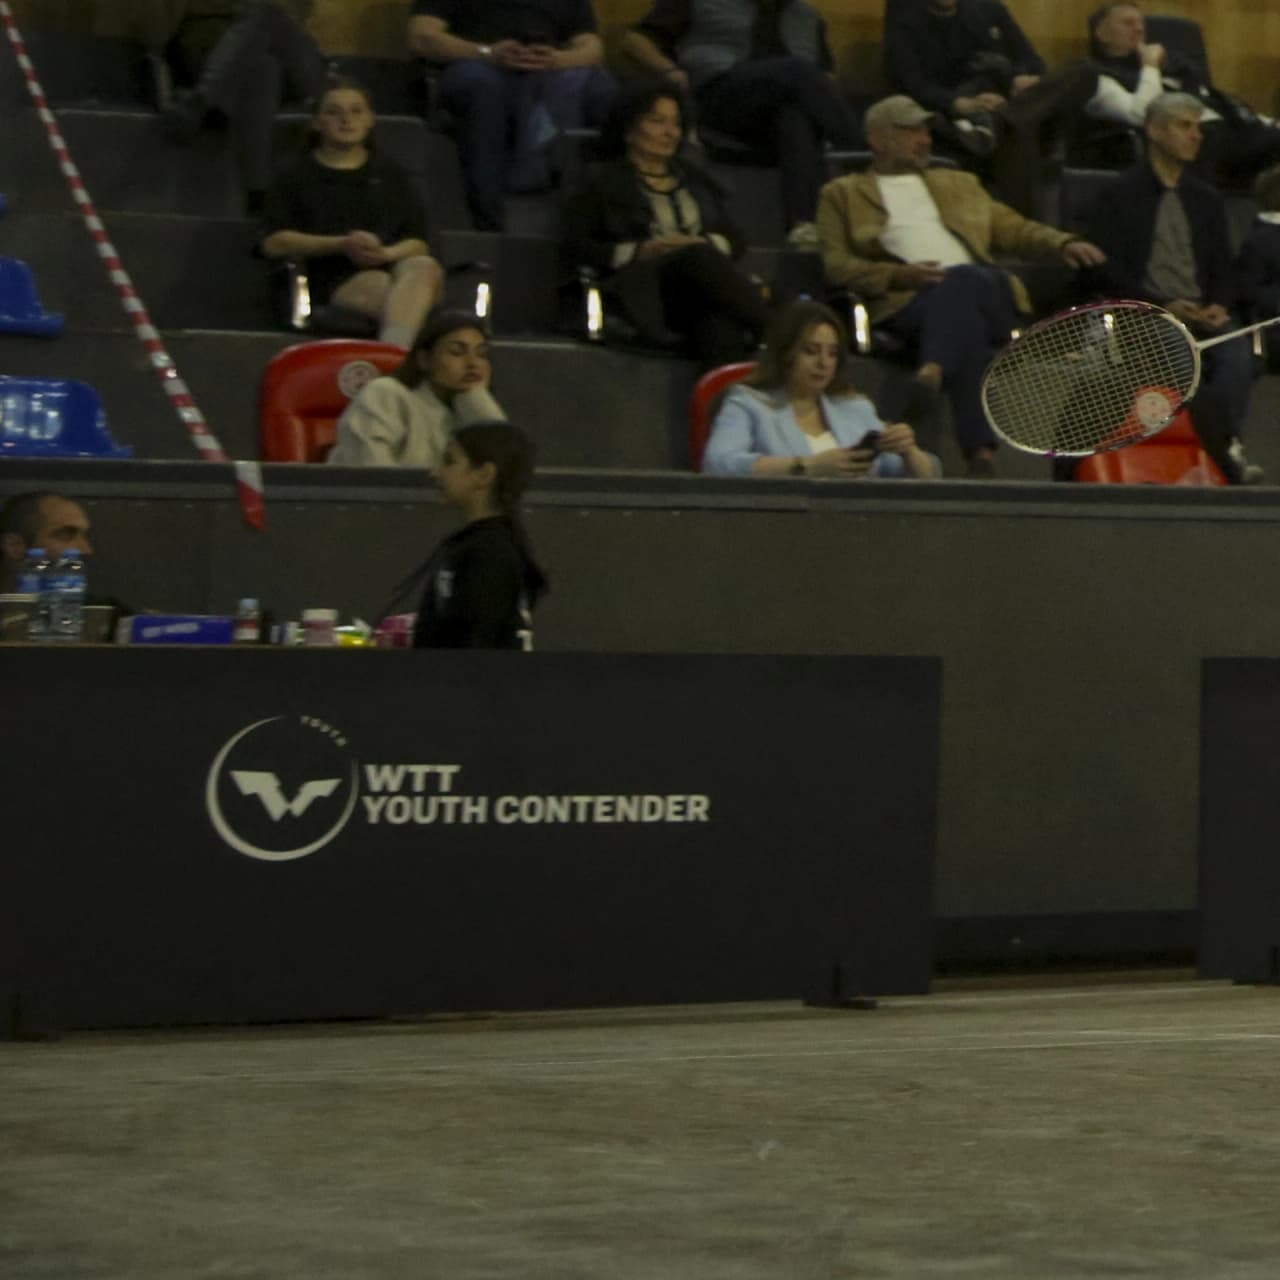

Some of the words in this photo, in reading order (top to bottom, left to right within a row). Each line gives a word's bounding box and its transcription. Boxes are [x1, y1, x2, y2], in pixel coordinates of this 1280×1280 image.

[363, 764, 462, 793] WTT
[361, 795, 489, 825] YOUTH
[494, 793, 711, 824] CONTENDER
